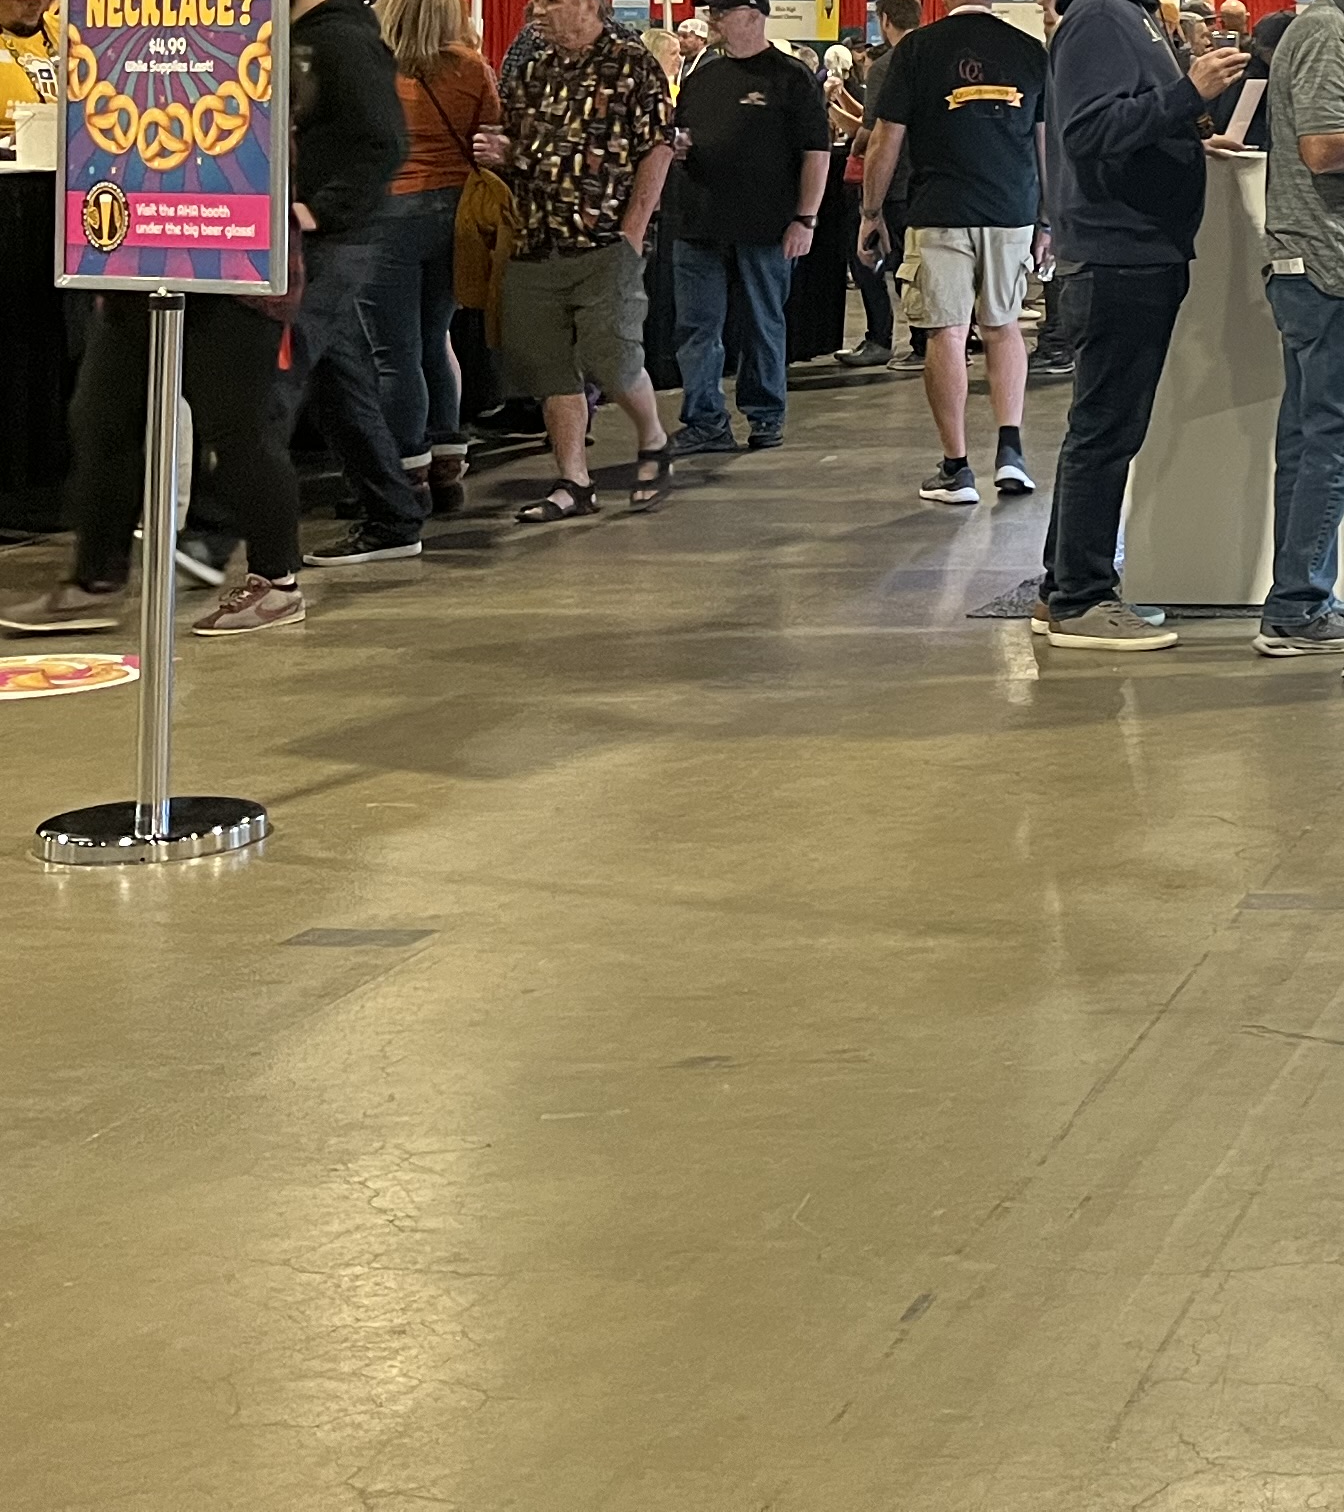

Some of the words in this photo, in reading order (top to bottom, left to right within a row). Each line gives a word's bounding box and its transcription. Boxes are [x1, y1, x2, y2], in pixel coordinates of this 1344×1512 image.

[148, 37, 187, 56] $4.99
[149, 61, 188, 74] Supplies
[159, 203, 175, 217] the
[200, 204, 230, 218] booth
[136, 223, 163, 234] under
[165, 222, 181, 235] the
[183, 223, 199, 238] big
